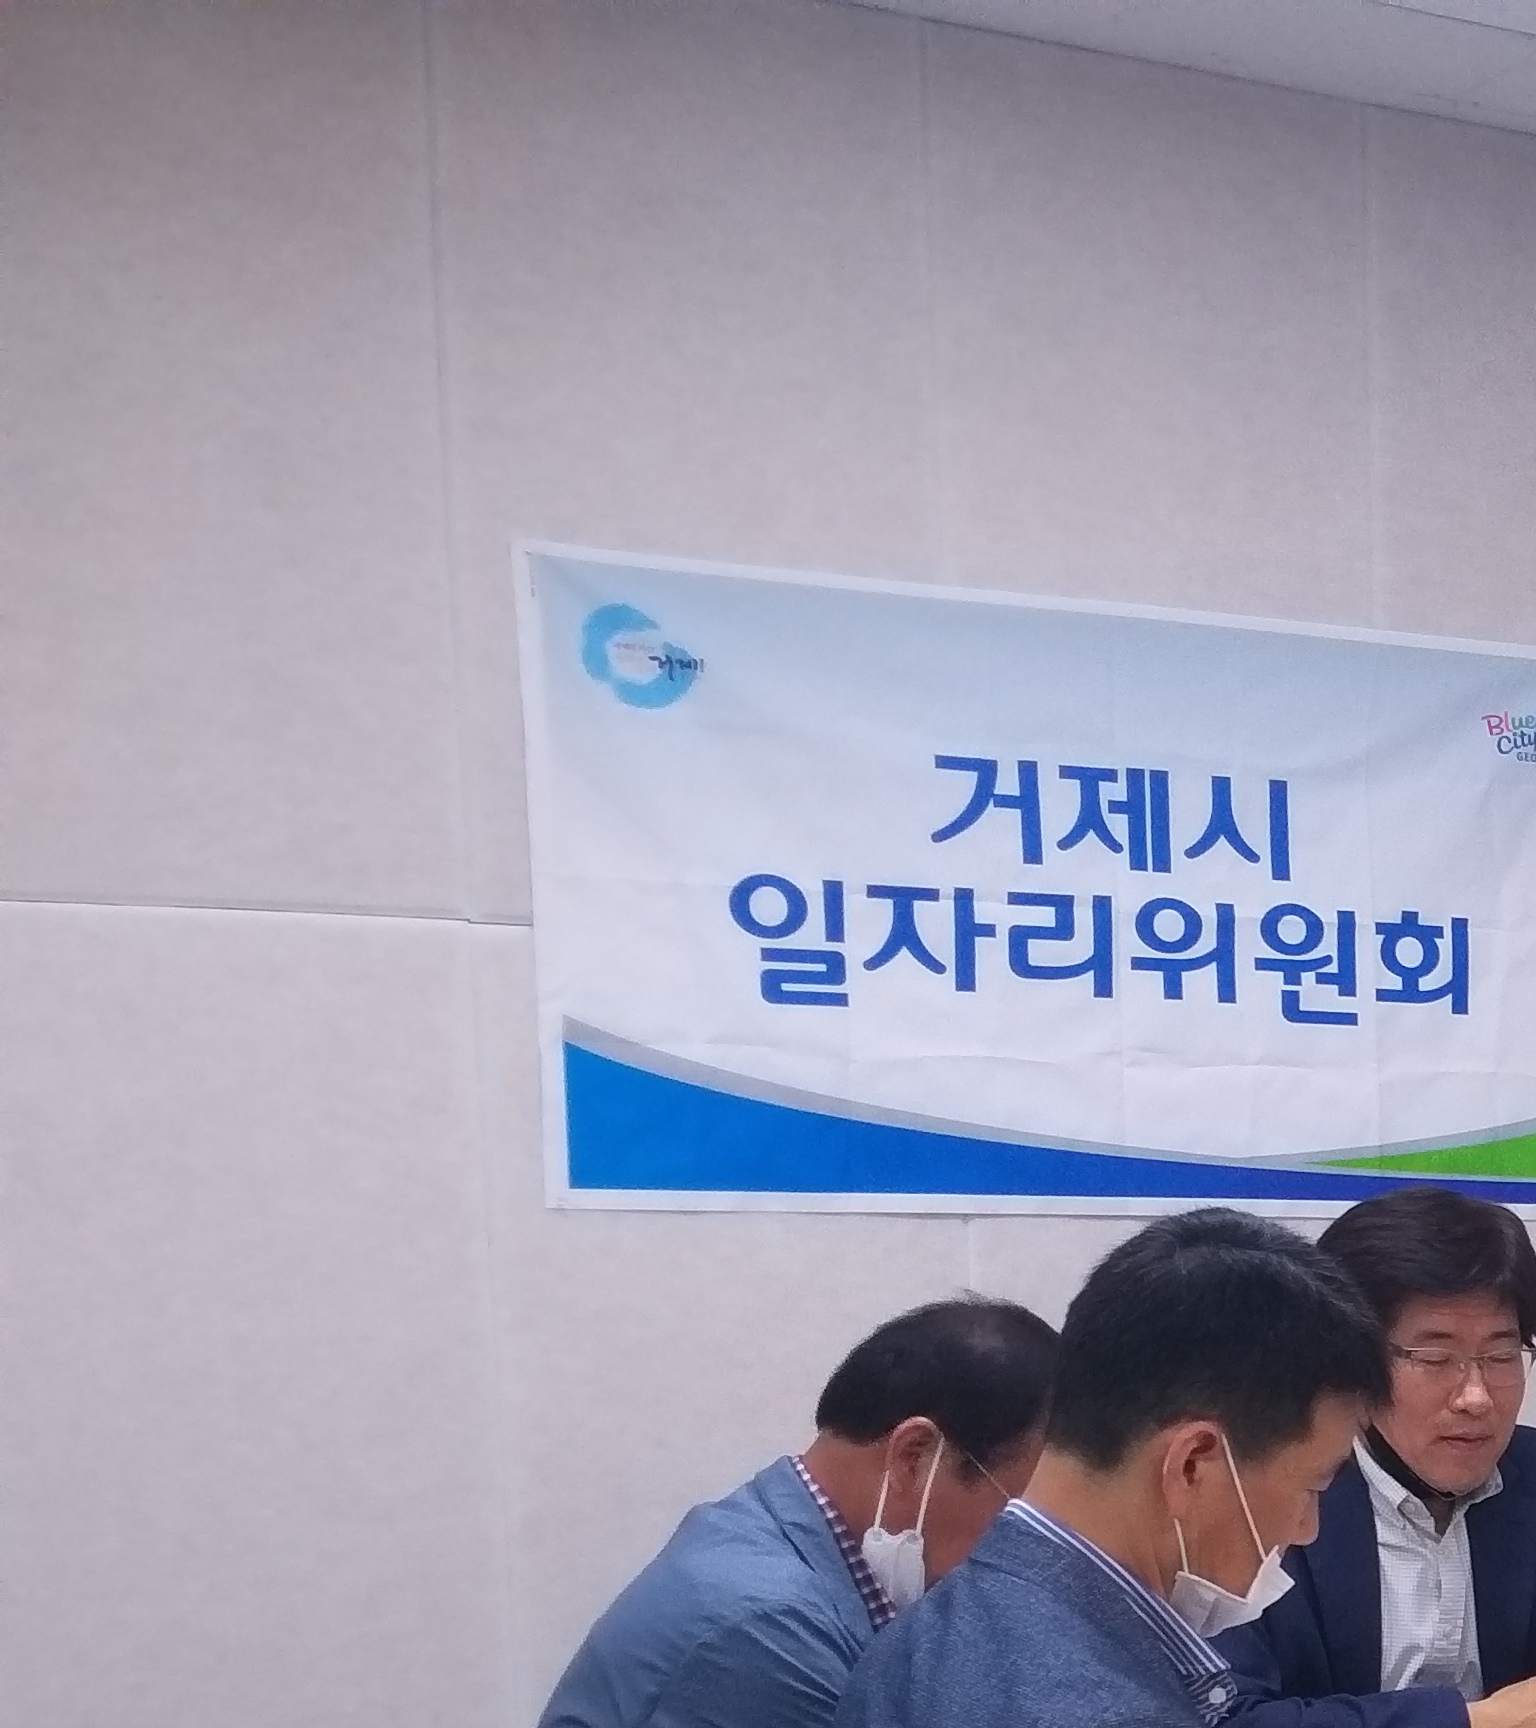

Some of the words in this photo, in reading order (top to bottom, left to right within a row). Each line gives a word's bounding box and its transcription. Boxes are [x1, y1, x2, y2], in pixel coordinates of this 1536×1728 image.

[1481, 711, 1536, 736] Blue
[1497, 730, 1536, 754] City
[930, 754, 1291, 882] 거제시
[728, 874, 1470, 1027] 일자리위원회
